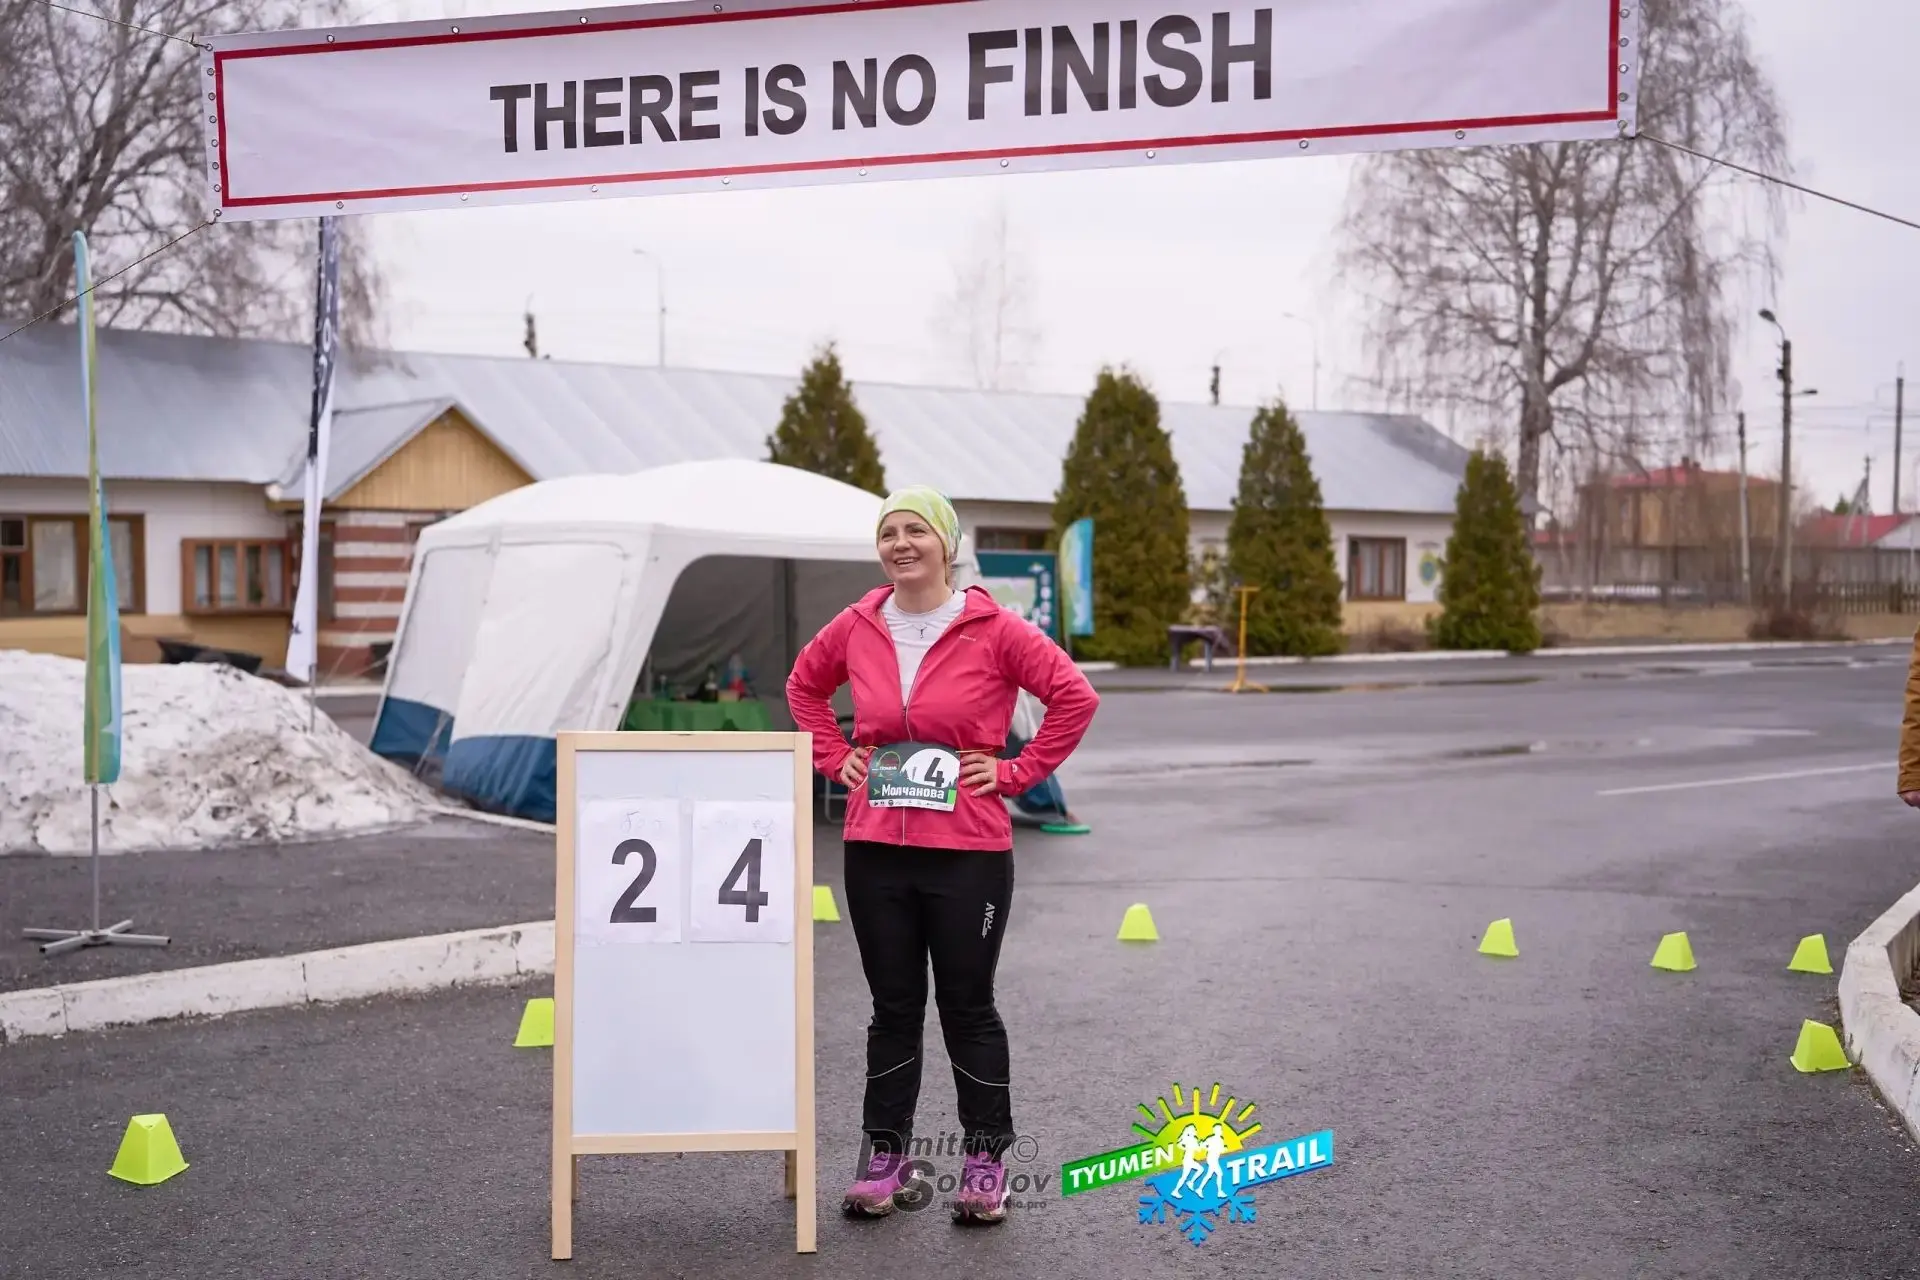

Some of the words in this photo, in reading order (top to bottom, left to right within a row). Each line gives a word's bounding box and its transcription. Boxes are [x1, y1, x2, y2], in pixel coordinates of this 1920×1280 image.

[490, 70, 721, 153] THERE
[744, 63, 807, 137] IS
[832, 54, 937, 131] NO
[968, 8, 1273, 121] FINISH
[881, 784, 945, 800] Молчанова
[924, 757, 945, 788] 4
[609, 838, 657, 924] 2
[718, 838, 769, 923] 4
